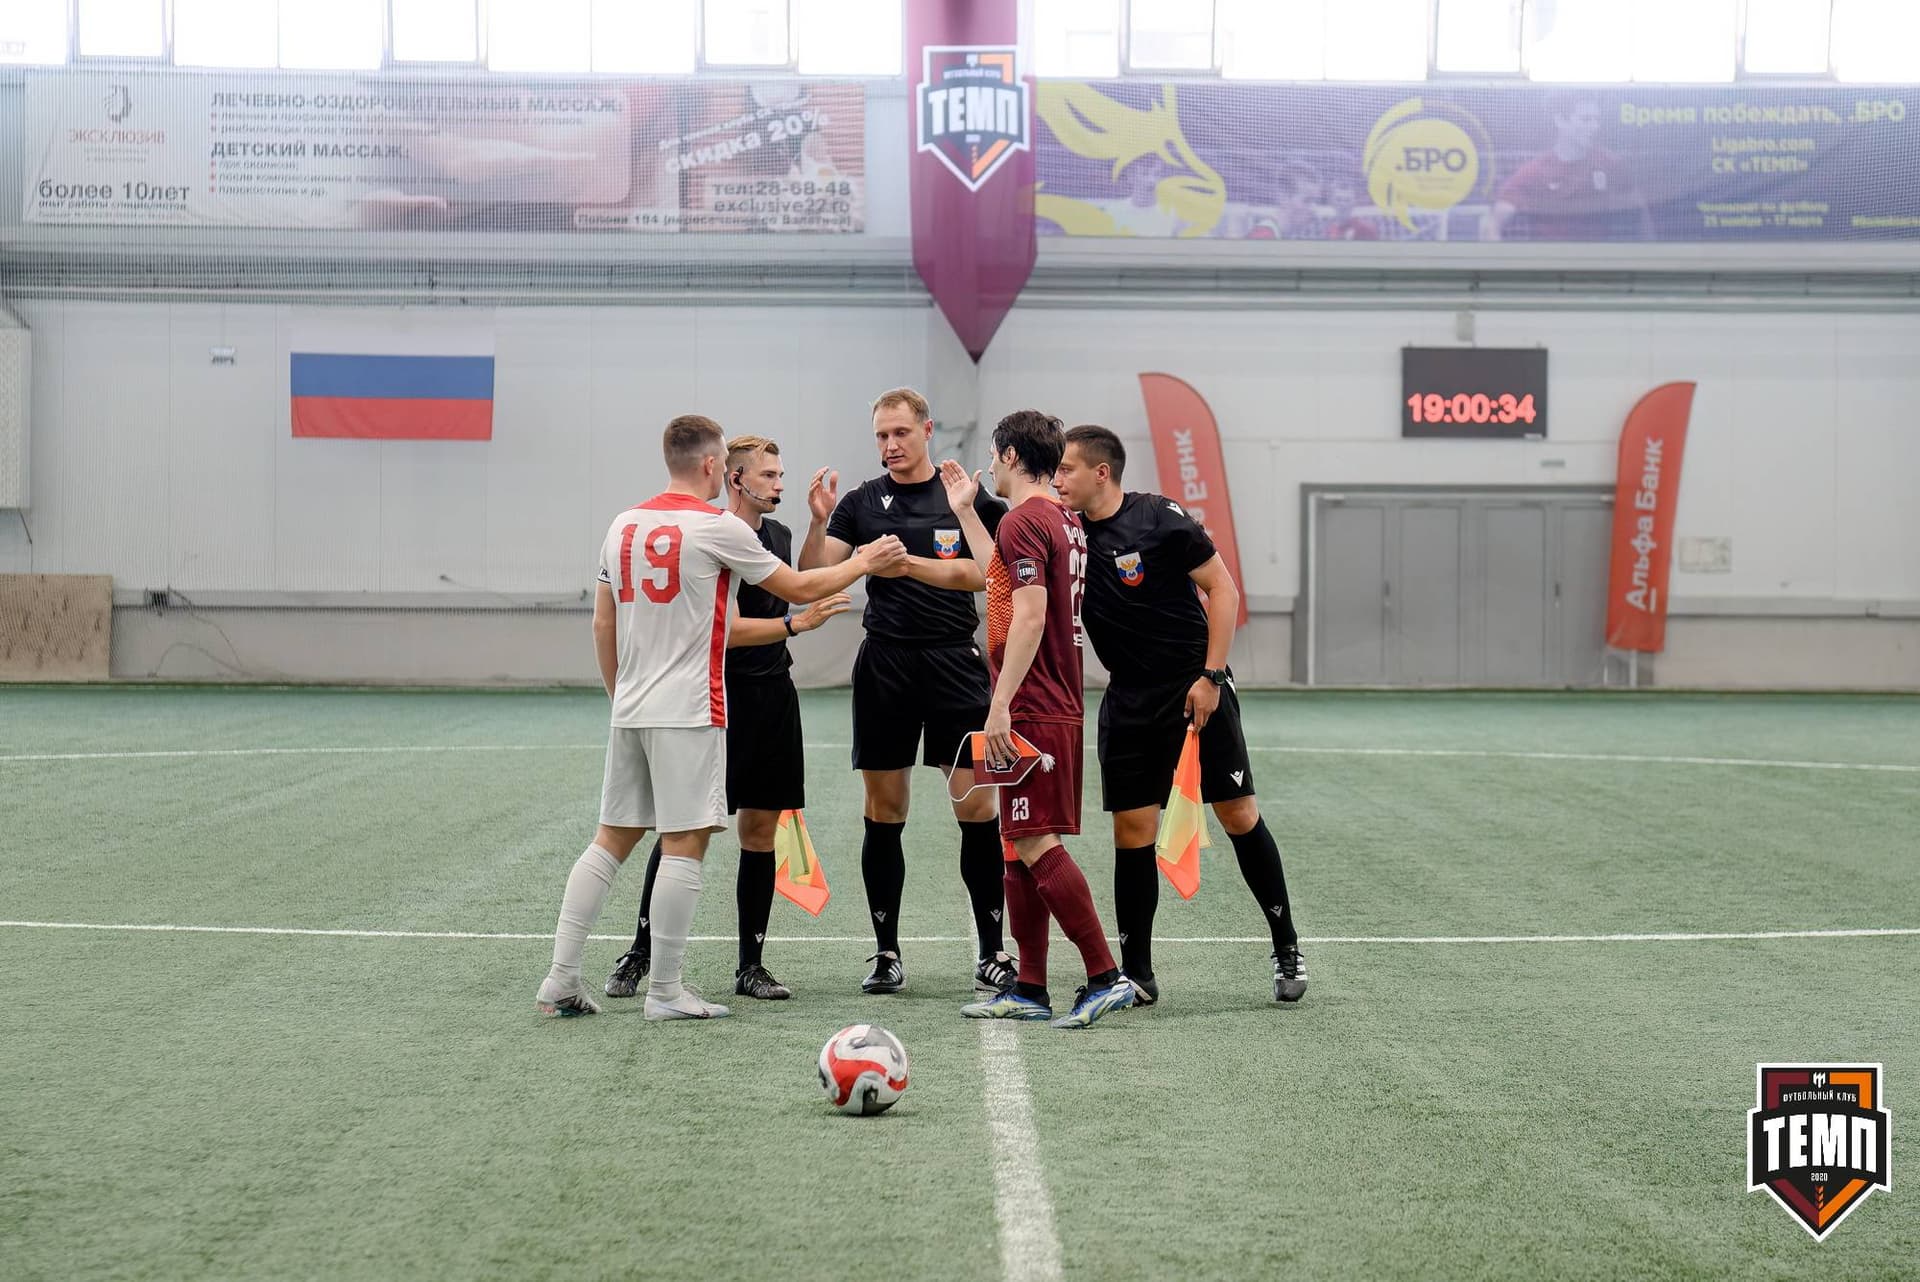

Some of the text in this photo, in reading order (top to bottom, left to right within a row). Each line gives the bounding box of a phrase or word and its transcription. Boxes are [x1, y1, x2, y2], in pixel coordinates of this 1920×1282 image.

[928, 86, 1018, 136] ТЕМП
[1620, 100, 1904, 127] Время побеждать, .БРО
[68, 128, 165, 144] ЭКСКЛЮЗИВ
[767, 108, 829, 142] 20%
[211, 140, 306, 158] ДЕТСКИЙ
[1395, 146, 1467, 173] .БРО
[39, 178, 190, 201] более 10лет
[1408, 393, 1536, 423] 19:00:34
[1625, 438, 1664, 611] Альфа Банк
[618, 523, 684, 604] 19
[1012, 797, 1030, 821] 23
